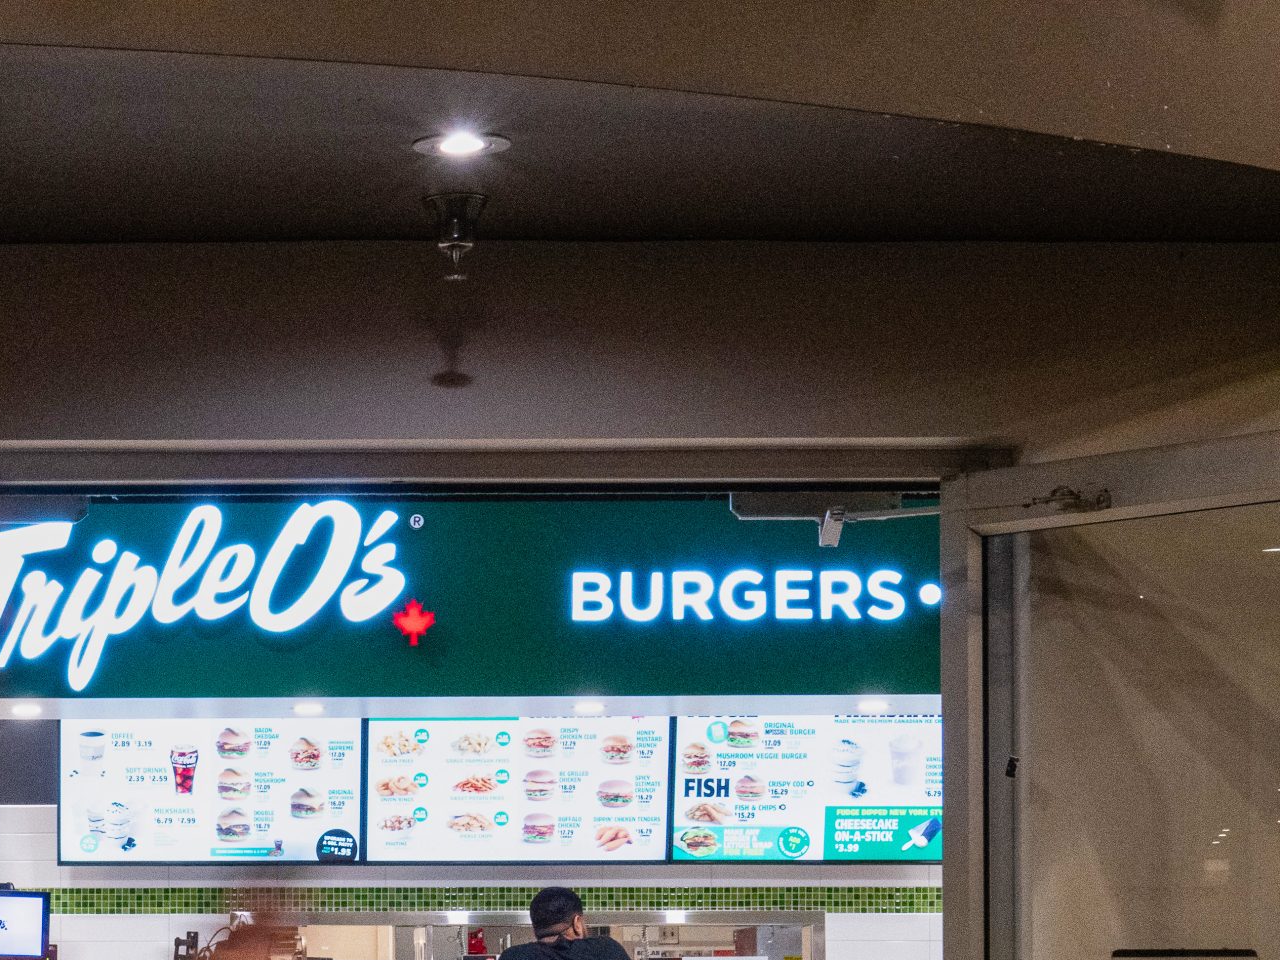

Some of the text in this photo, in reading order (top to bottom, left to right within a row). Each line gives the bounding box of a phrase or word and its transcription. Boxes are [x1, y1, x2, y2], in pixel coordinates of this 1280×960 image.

[572, 569, 906, 622] BURGERS
[683, 778, 731, 798] FISH
[834, 819, 899, 830] CHEESECAKE
[835, 831, 893, 842] ON-A-STICK
